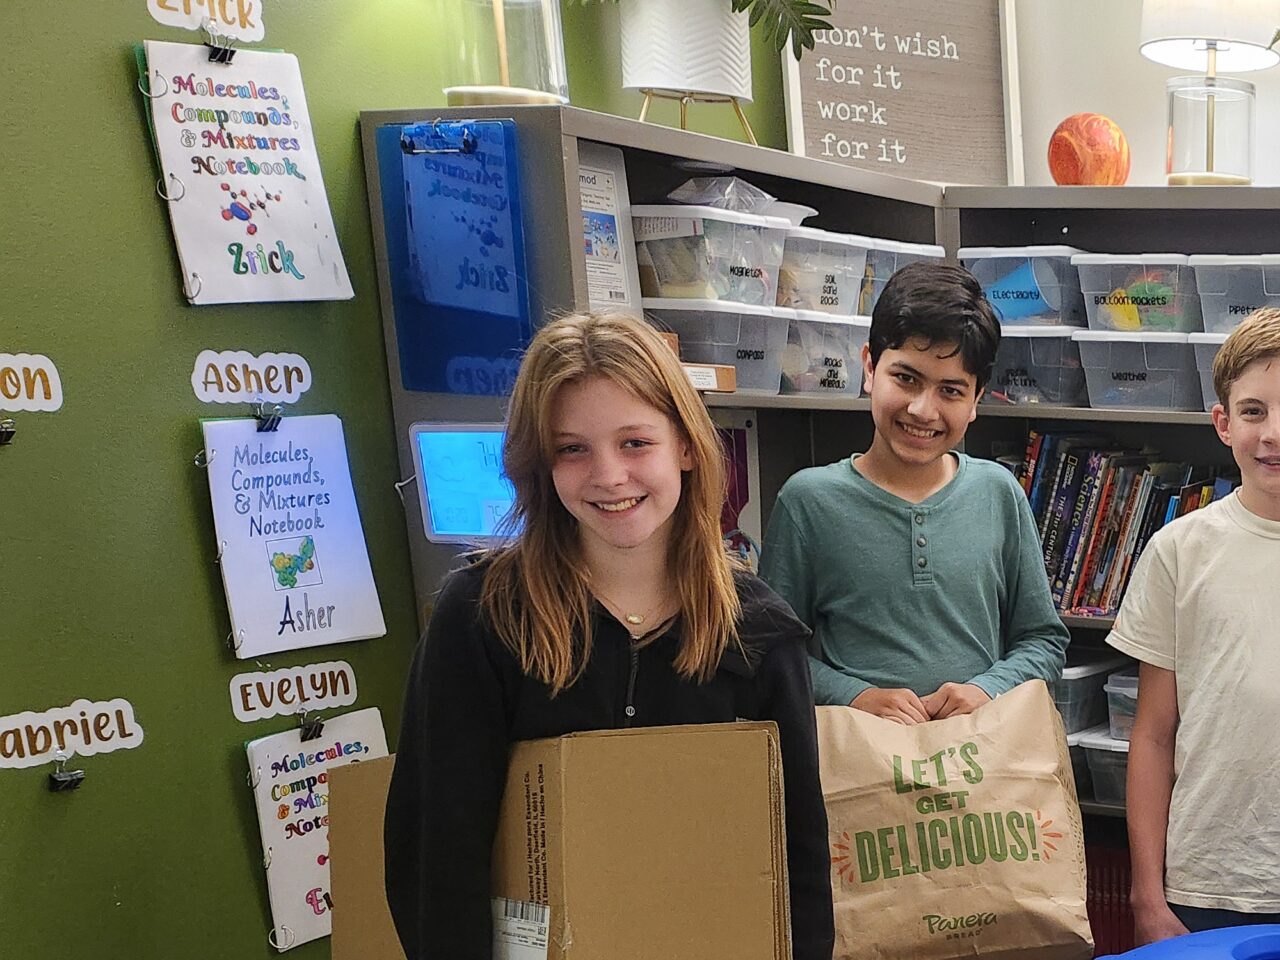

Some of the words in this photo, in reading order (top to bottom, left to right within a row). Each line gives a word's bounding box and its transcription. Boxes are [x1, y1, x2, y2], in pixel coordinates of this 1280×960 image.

[893, 32, 960, 61] wish
[815, 58, 864, 85] for
[872, 64, 902, 90] it
[172, 73, 289, 108] Molecules,
[171, 102, 299, 130] Compounds,
[817, 100, 888, 126] work
[180, 129, 197, 148] &
[201, 129, 302, 152] Mixtures
[820, 133, 869, 157] for
[877, 138, 907, 164] it
[192, 155, 307, 181] Notebook
[1229, 304, 1257, 315] Pipett
[202, 363, 304, 394] Asher
[234, 441, 314, 467] Molecules,
[231, 468, 325, 493] Compounds,
[234, 494, 251, 515] &
[258, 491, 331, 512] Mixtures
[1058, 496, 1067, 512] THE
[1071, 474, 1095, 527] Science
[248, 510, 325, 537] Notebook
[1044, 526, 1058, 566] CENTURY
[278, 595, 336, 636] Asher
[271, 739, 370, 778] Molecules,
[893, 742, 984, 795] LET'S
[271, 771, 328, 802] Compo
[294, 791, 329, 815] Mix
[916, 790, 970, 815] GET
[285, 814, 330, 840] Note
[855, 810, 1040, 883] DELICIOUS!
[922, 911, 998, 935] Panera
[946, 928, 982, 941] BREAD
